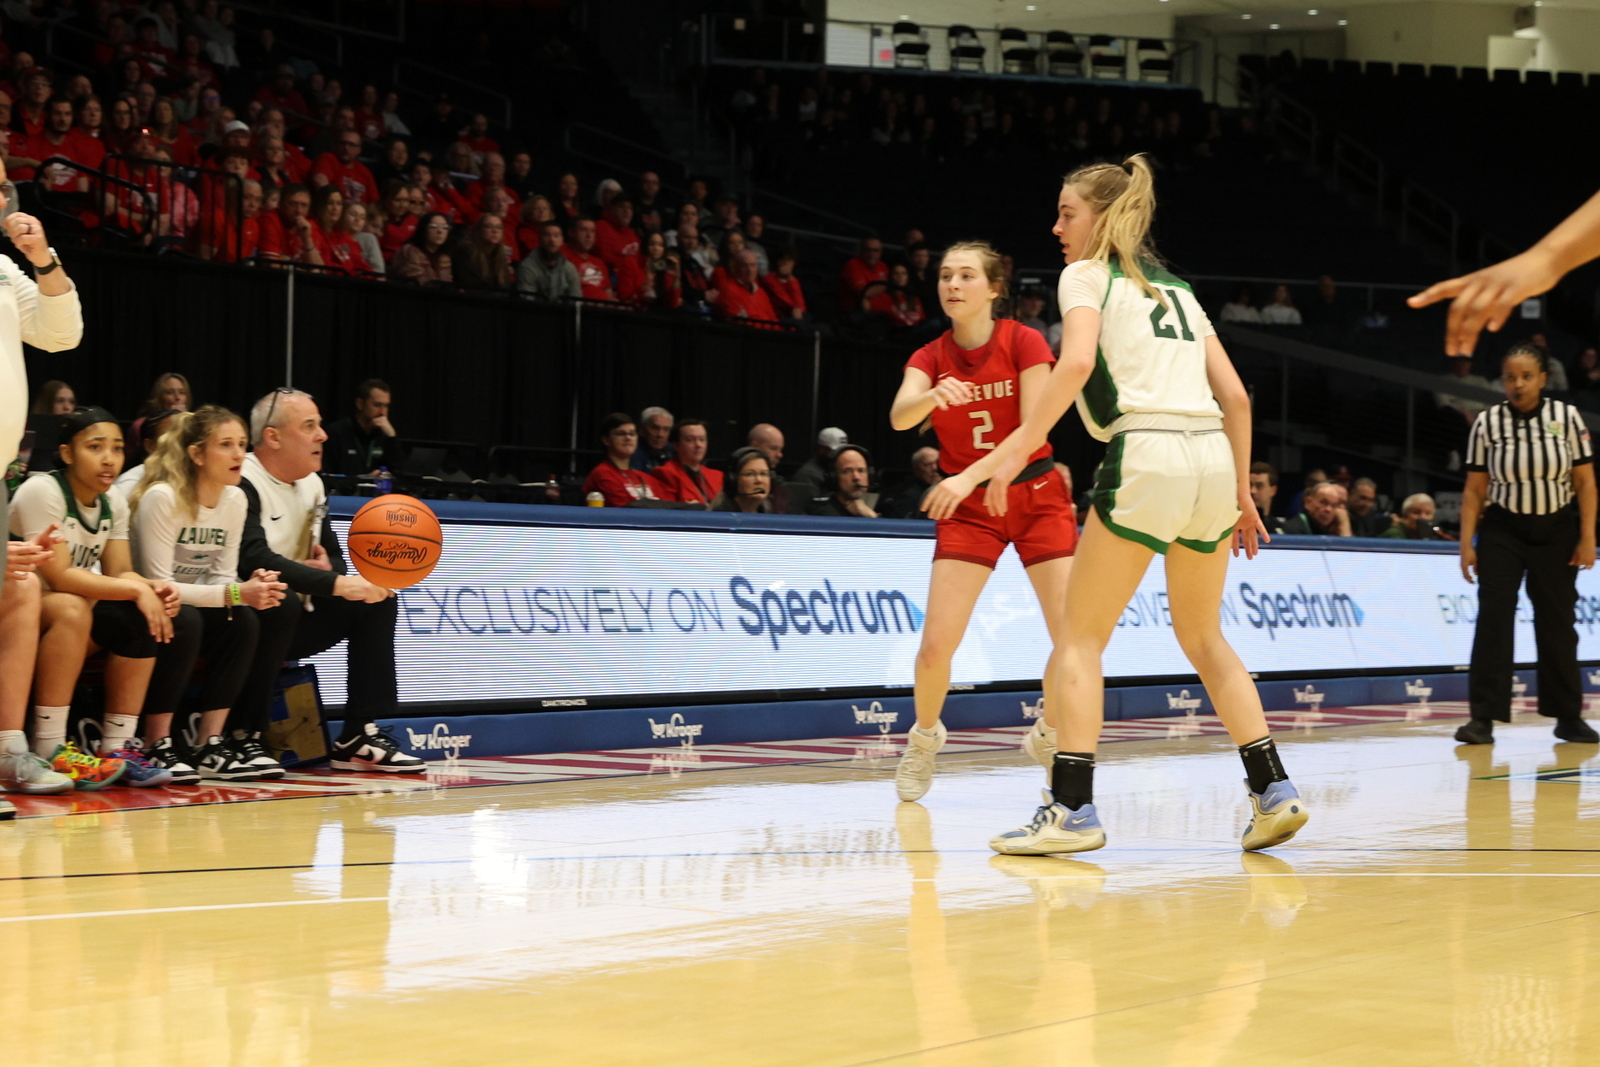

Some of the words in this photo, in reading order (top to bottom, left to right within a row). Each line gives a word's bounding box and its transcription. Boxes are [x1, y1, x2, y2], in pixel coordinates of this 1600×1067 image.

[1143, 287, 1195, 341] 21
[967, 380, 1014, 402] EVUE
[967, 410, 995, 450] 2
[366, 541, 427, 565] Rawlings
[397, 588, 652, 634] EXCLUSIVELY
[668, 588, 724, 633] ON
[730, 576, 917, 649] Spectrum
[1241, 582, 1360, 640] Spectrum
[428, 722, 471, 760] Kroger
[667, 714, 704, 747] Kroger
